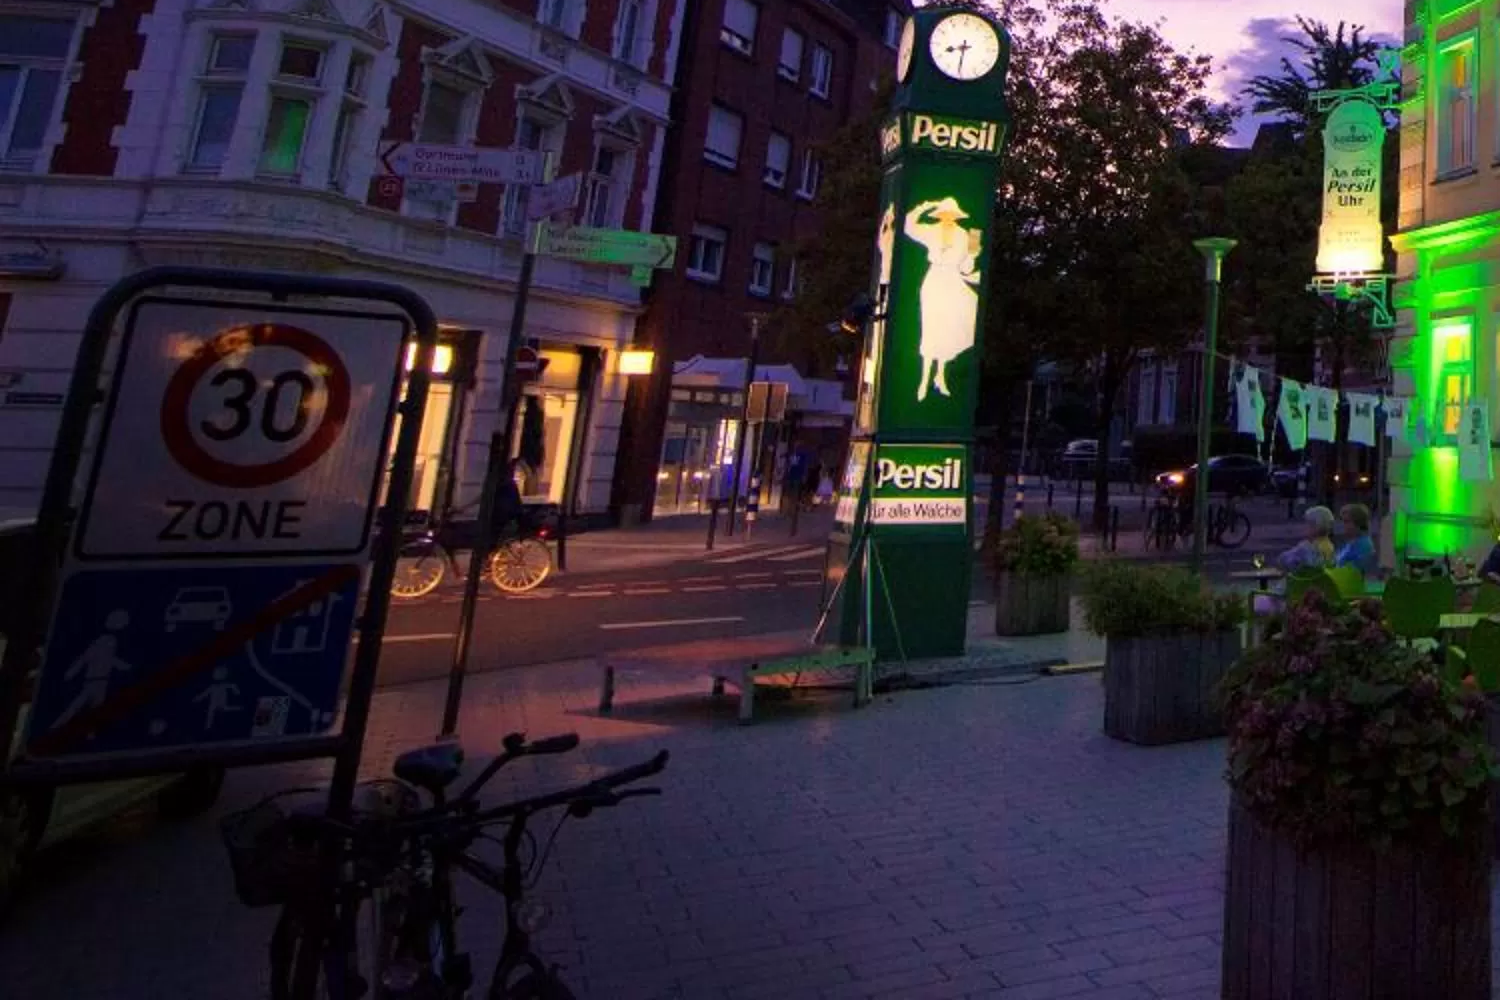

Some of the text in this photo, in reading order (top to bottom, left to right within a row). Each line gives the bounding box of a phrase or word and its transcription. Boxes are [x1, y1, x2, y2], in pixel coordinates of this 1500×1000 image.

[911, 115, 997, 152] Persil
[1327, 178, 1376, 194] Persil
[1338, 194, 1363, 207] Uhr
[201, 367, 315, 443] 30
[877, 458, 961, 490] Persil
[158, 500, 306, 541] ZONE
[888, 503, 911, 519] alle
